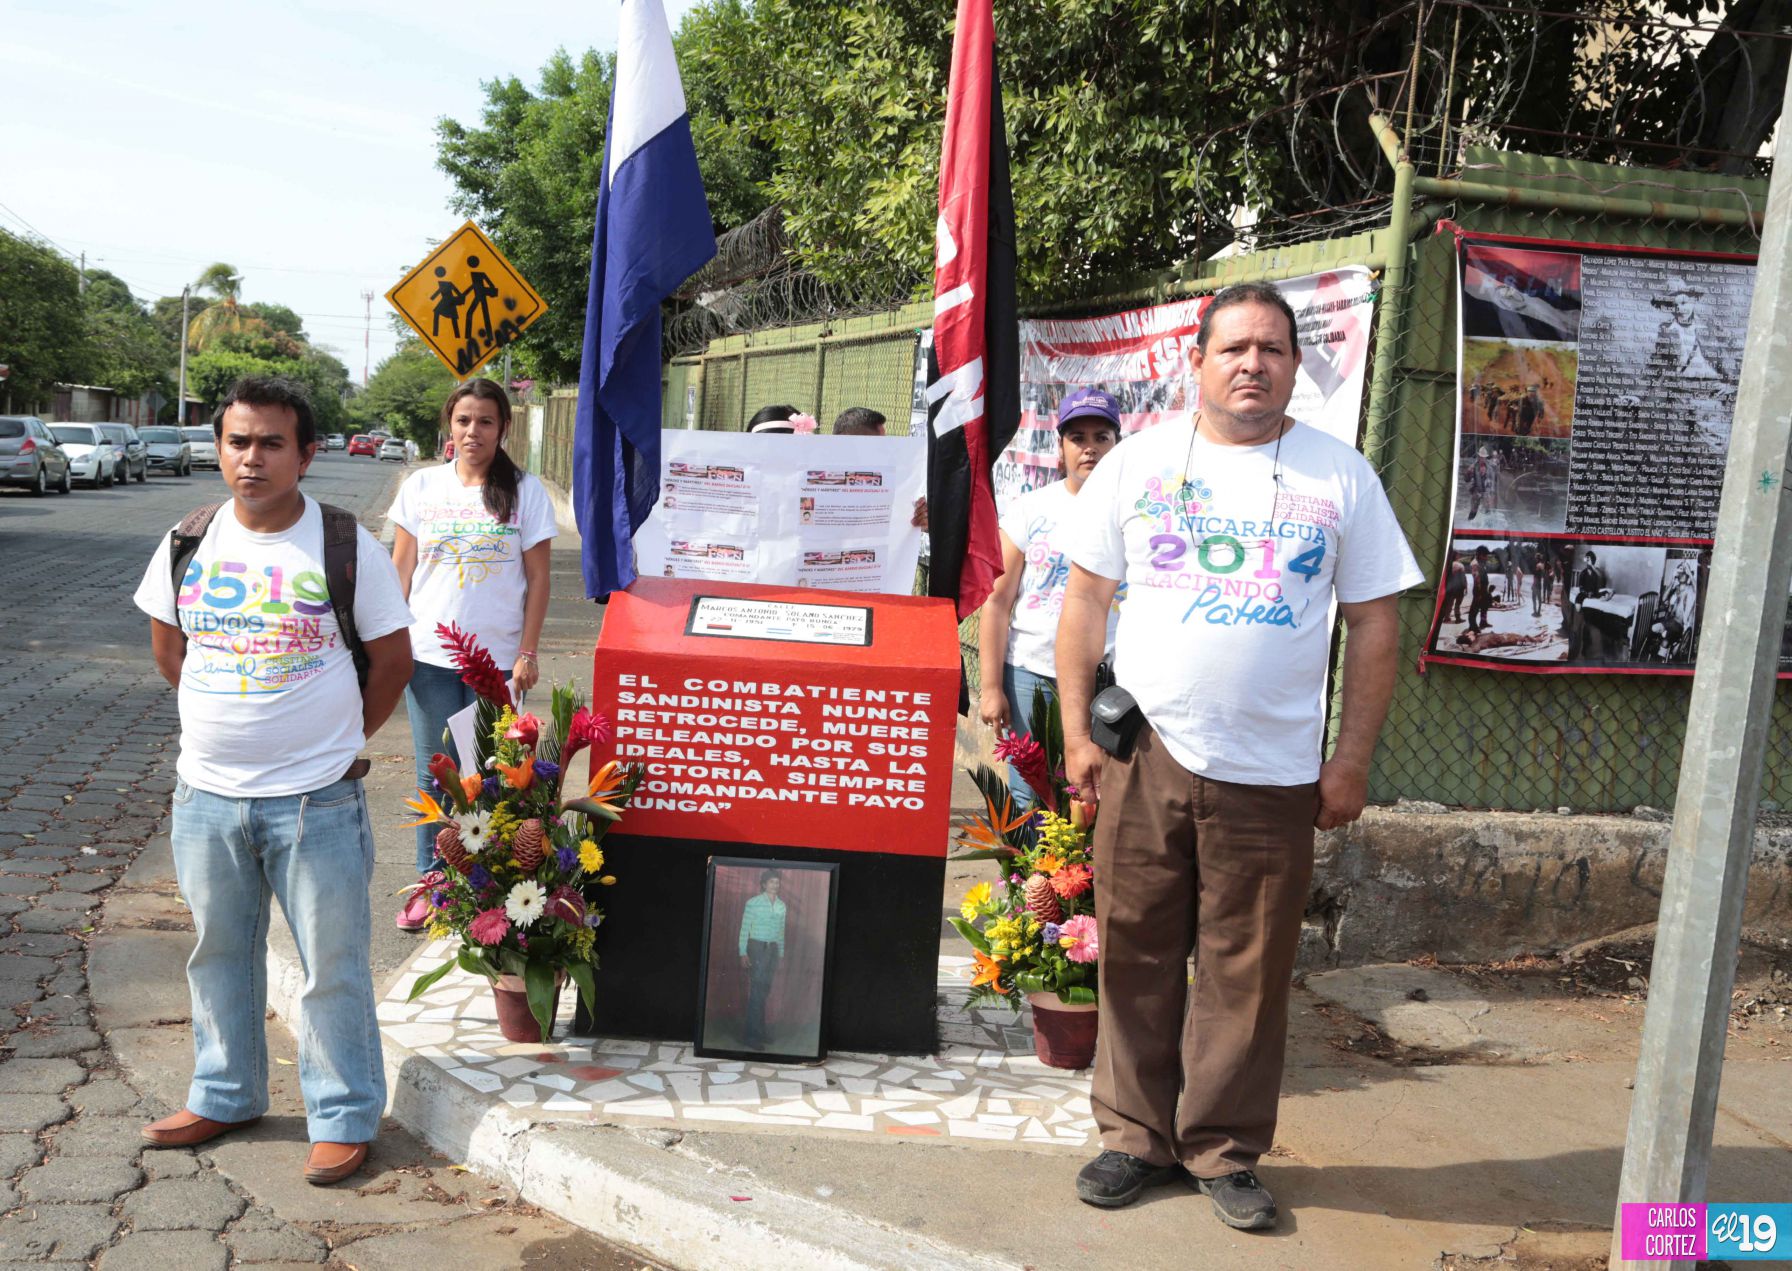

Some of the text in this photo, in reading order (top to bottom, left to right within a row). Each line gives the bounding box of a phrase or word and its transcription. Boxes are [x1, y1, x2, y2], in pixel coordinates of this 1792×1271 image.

[1274, 501, 1340, 522] SOCIALISTA
[1179, 516, 1326, 546] NICARAGUA
[1149, 534, 1326, 583] 2014
[1145, 573, 1282, 603] HACIENDO
[180, 609, 320, 637] NID@S EN
[701, 604, 738, 613] MARCOS
[741, 606, 778, 615] ANTONIO
[786, 610, 820, 618] SOLANO
[618, 673, 931, 705] EL COMBATIENTE
[617, 691, 931, 723] SANDINISTA NUNCA
[617, 708, 929, 740] RETROCEDE, MUERE
[616, 726, 928, 758] PELEANDO POR SUS
[615, 743, 927, 775] IDEALES, HASTA LA
[787, 772, 926, 793] SIEMPRE
[848, 793, 925, 810] PAYO
